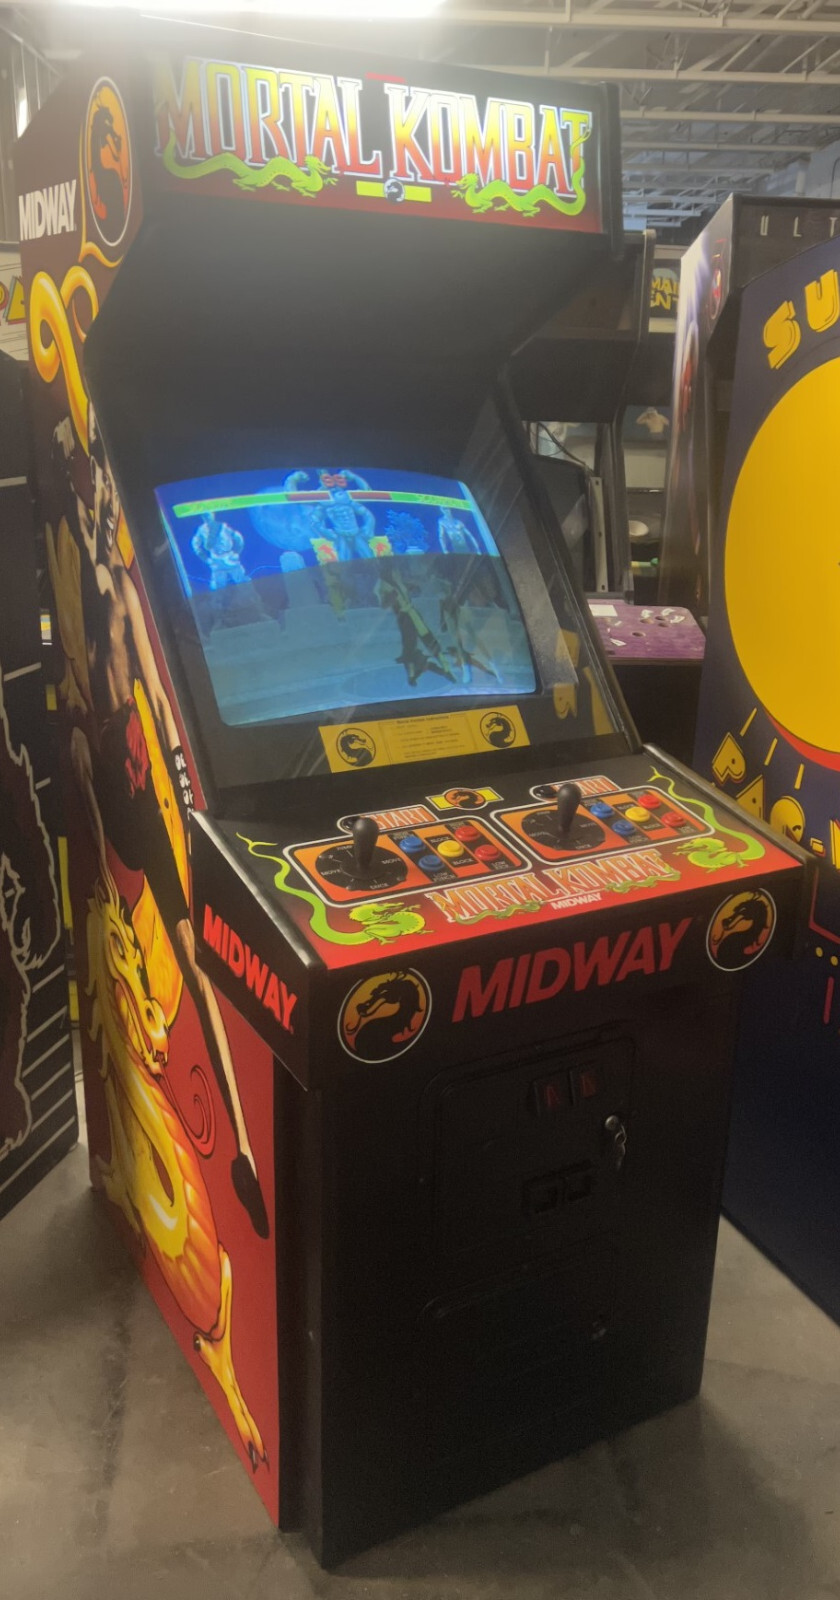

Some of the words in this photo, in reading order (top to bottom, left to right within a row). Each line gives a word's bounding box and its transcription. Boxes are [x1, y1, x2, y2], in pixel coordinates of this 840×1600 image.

[152, 56, 382, 178] MORTAL
[383, 83, 593, 198] KOMBAT
[18, 179, 76, 241] MIDWAY
[550, 892, 602, 910] MIDWAY
[202, 904, 297, 1032] MIDWAY
[452, 917, 694, 1023] MIDWAY
